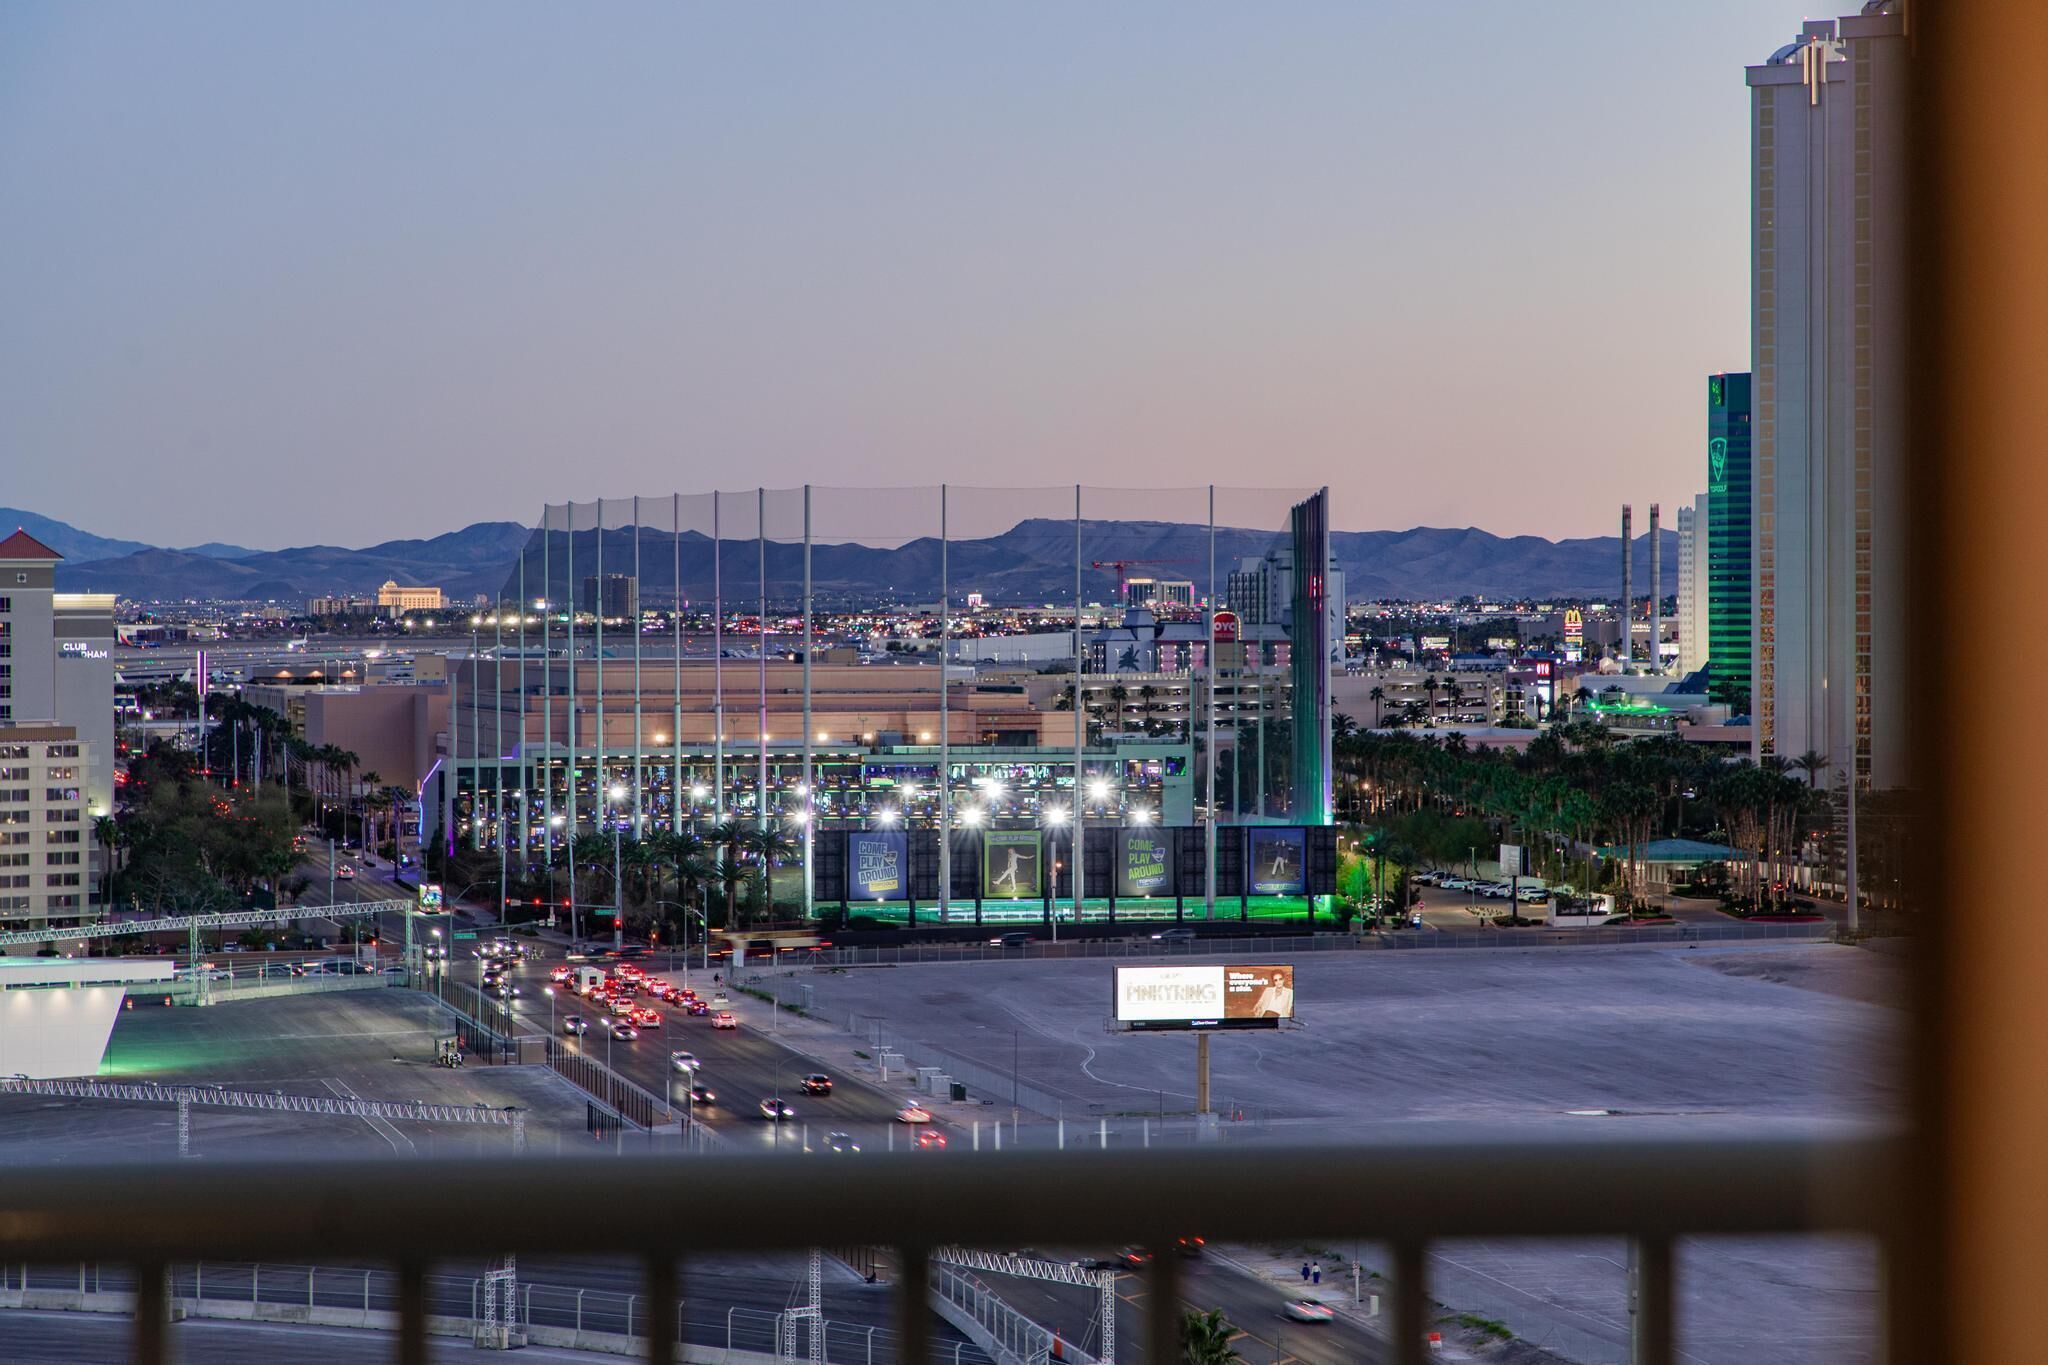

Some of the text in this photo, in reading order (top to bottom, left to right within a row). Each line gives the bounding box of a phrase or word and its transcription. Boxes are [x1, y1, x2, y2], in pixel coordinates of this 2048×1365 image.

[63, 642, 87, 651] CLUB
[1536, 663, 1550, 675] OYO
[860, 841, 888, 855] COME
[1128, 838, 1155, 851] COME
[861, 855, 884, 868] PLAY
[1129, 852, 1151, 864] PLAY
[860, 866, 898, 883] AROUND
[1129, 863, 1164, 880] AROUND
[1228, 972, 1254, 980] Where
[1228, 978, 1269, 986] everyone's
